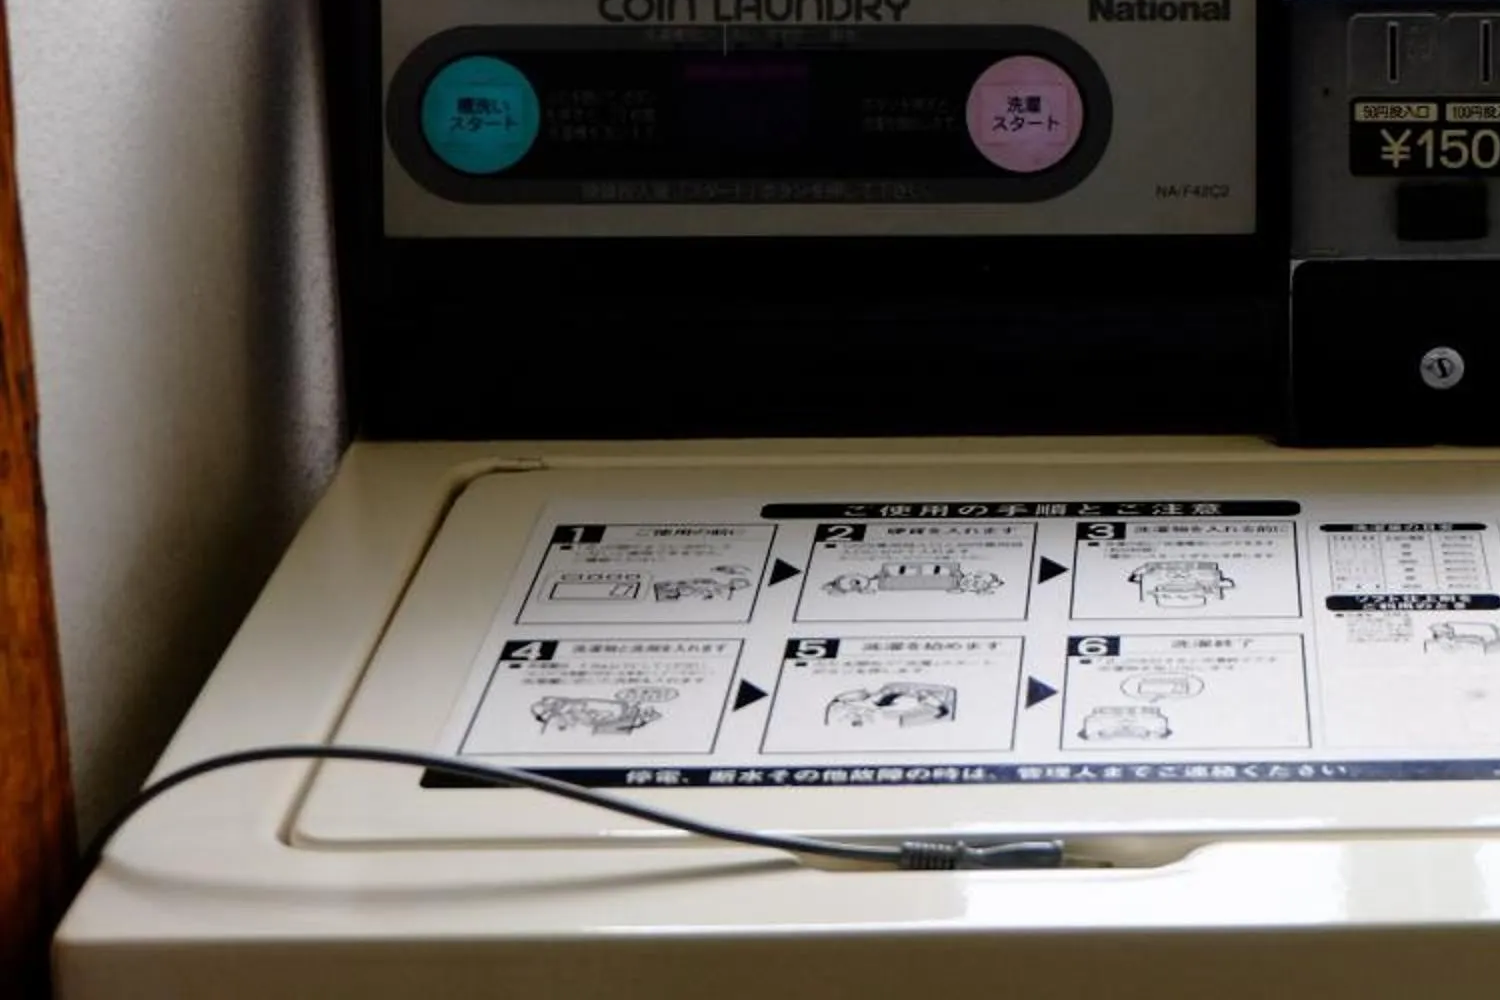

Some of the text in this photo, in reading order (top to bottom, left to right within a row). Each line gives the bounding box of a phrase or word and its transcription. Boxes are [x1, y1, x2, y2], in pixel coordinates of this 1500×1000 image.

[1007, 96, 1041, 114] 洗濯
[449, 116, 520, 132] スタート
[992, 116, 1060, 132] スタート
[844, 503, 1225, 517] ご使用の手順とご注意
[826, 525, 855, 541] 2
[1087, 523, 1115, 540] 3
[511, 641, 543, 660] 4
[796, 639, 827, 658] 5
[1077, 637, 1108, 656] 6
